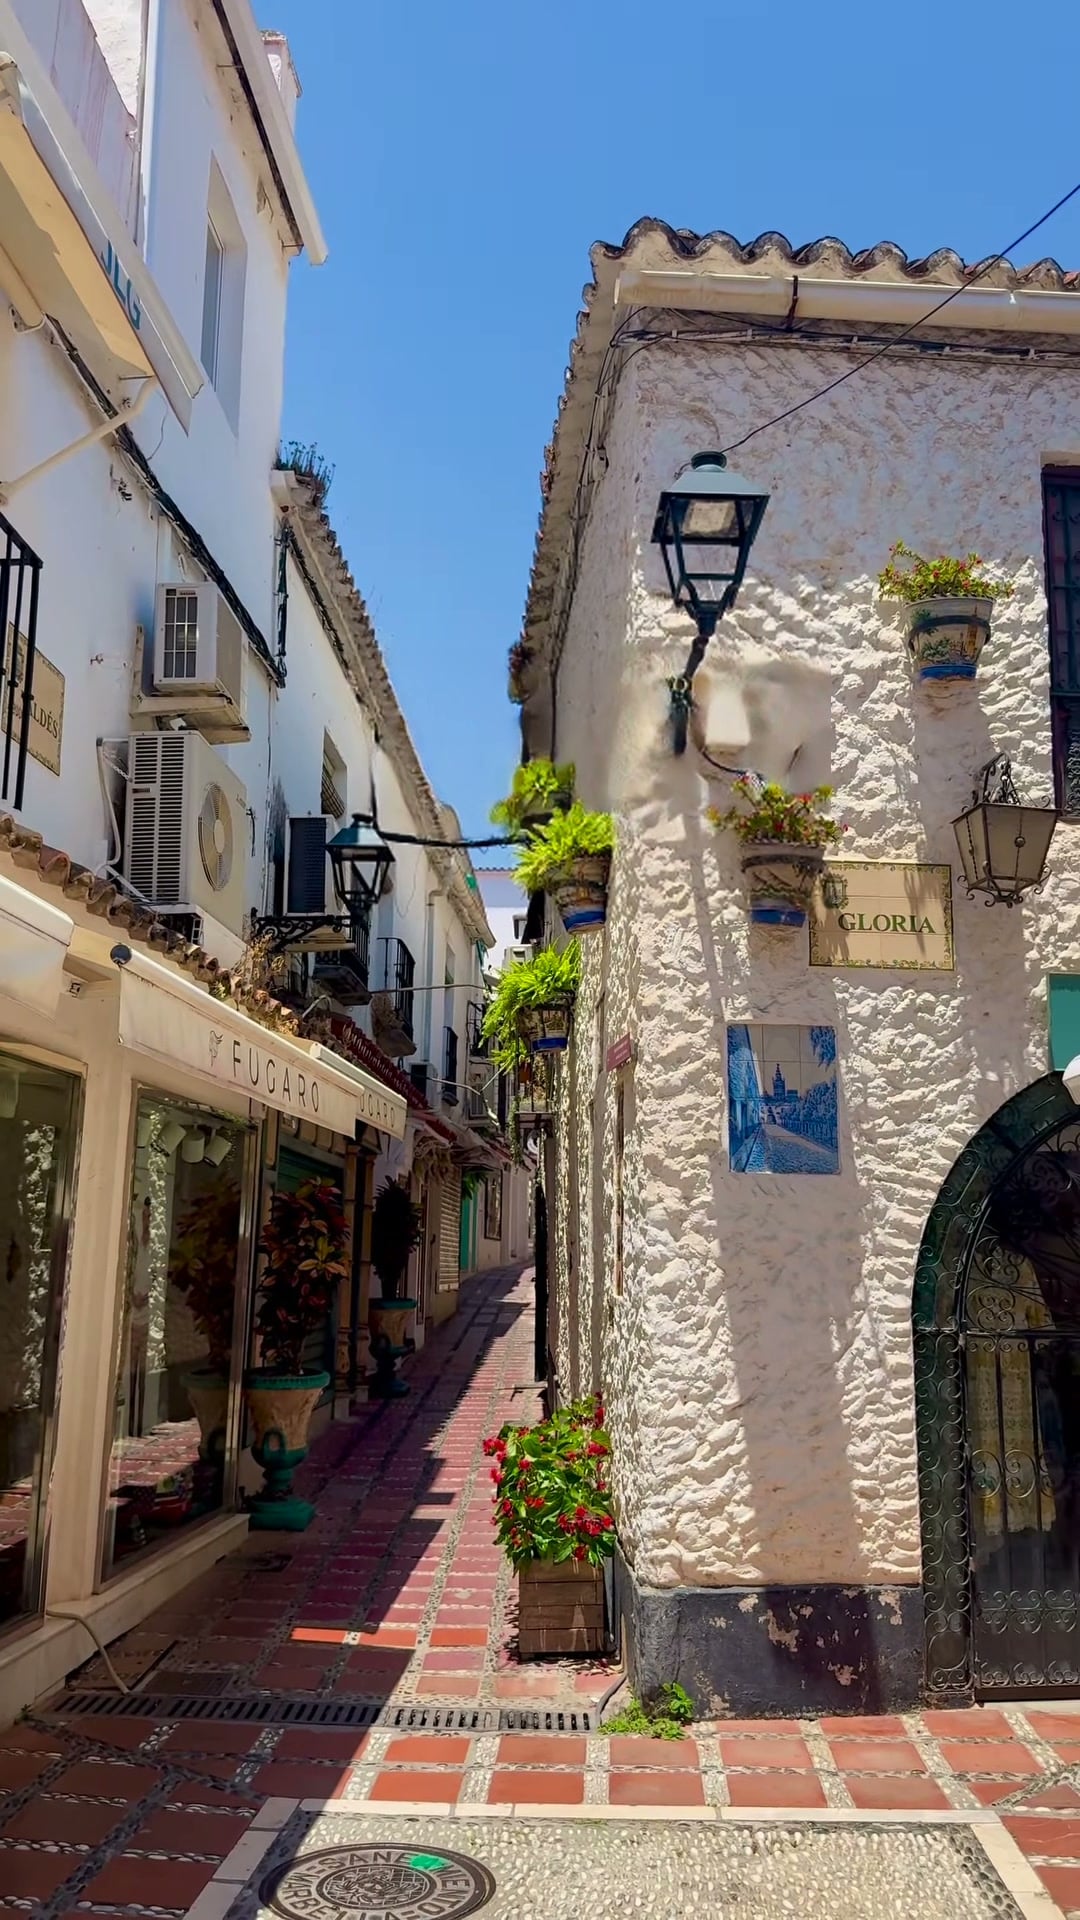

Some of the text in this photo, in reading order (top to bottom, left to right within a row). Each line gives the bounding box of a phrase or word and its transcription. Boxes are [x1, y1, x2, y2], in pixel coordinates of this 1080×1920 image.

[838, 912, 936, 934] GLORIA
[231, 1039, 320, 1113] FUGARO
[359, 1093, 395, 1129] UGARO
